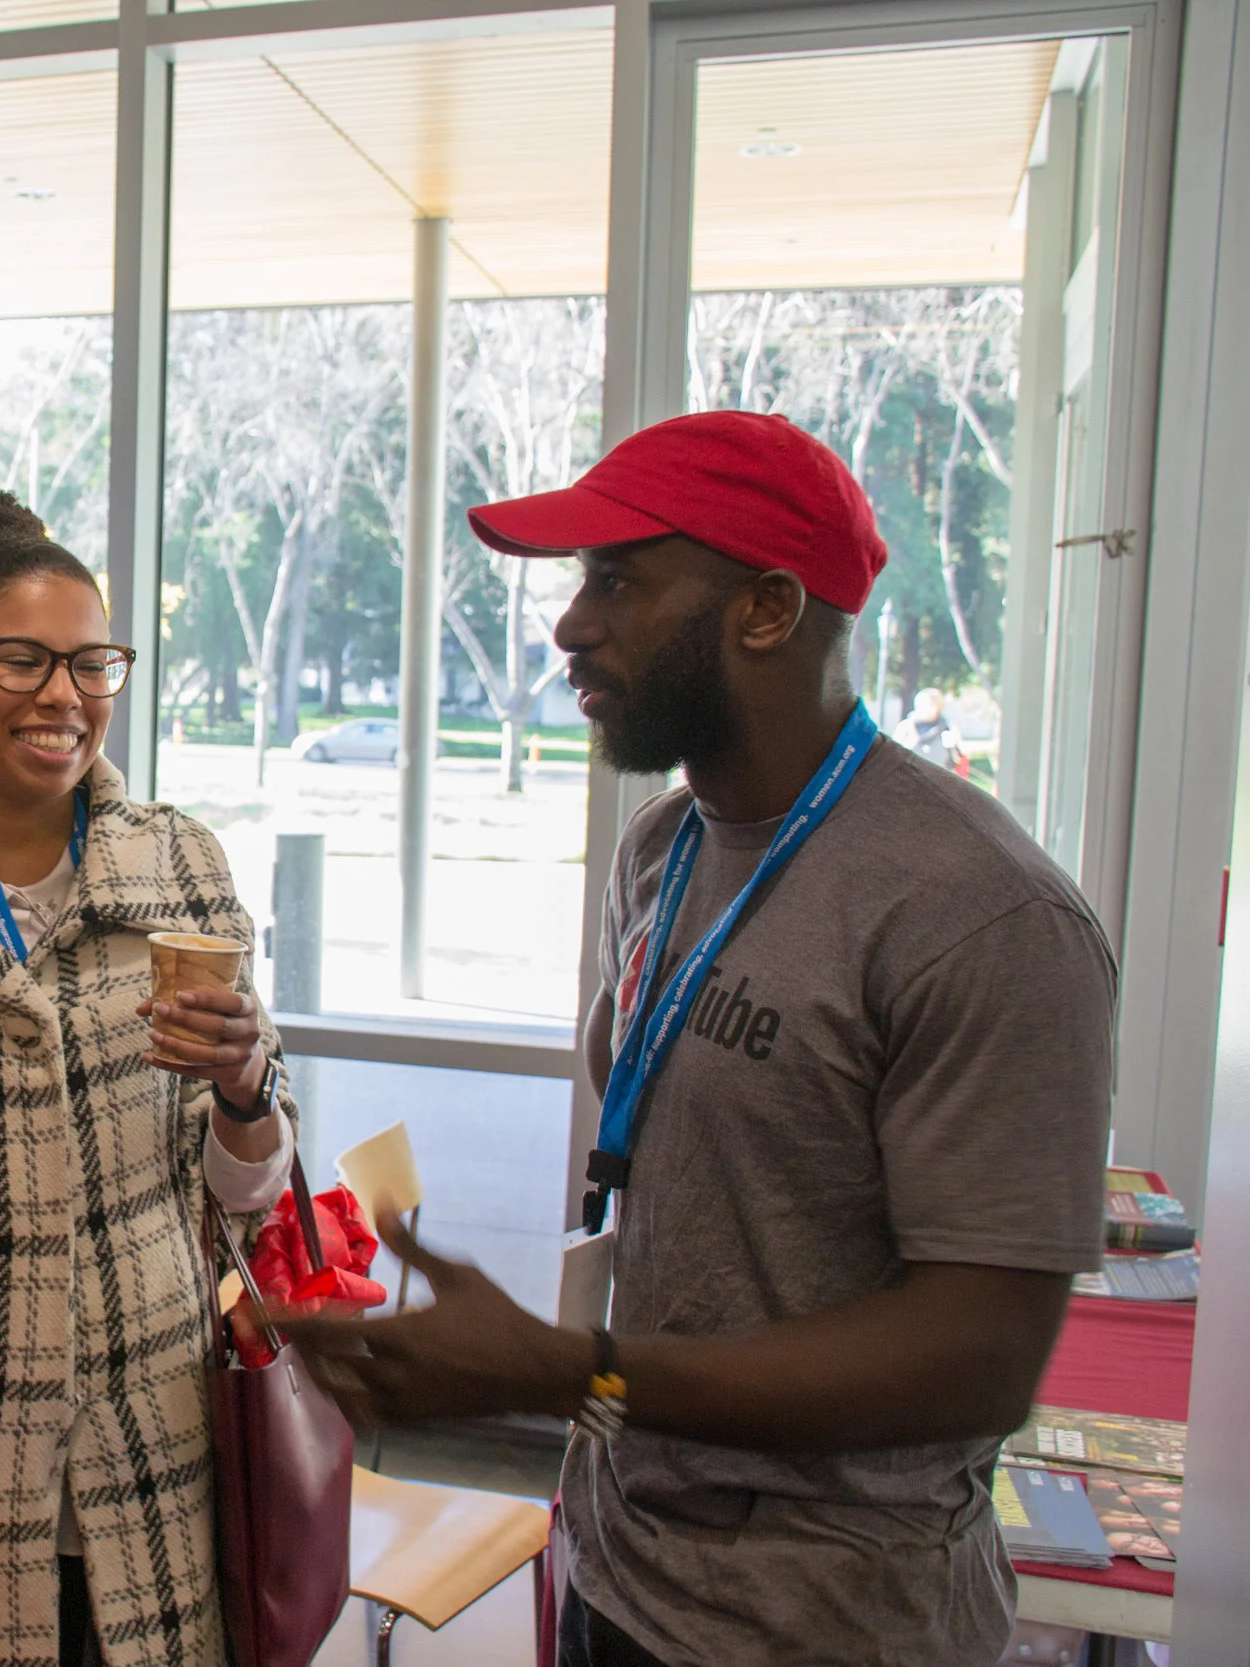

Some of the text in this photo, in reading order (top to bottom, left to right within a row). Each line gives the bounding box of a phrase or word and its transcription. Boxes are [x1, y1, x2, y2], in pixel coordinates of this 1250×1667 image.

[809, 744, 856, 809] women.acm.org
[673, 863, 684, 877] for
[652, 1002, 680, 1051] supporting,
[674, 953, 704, 1002] celebrating,
